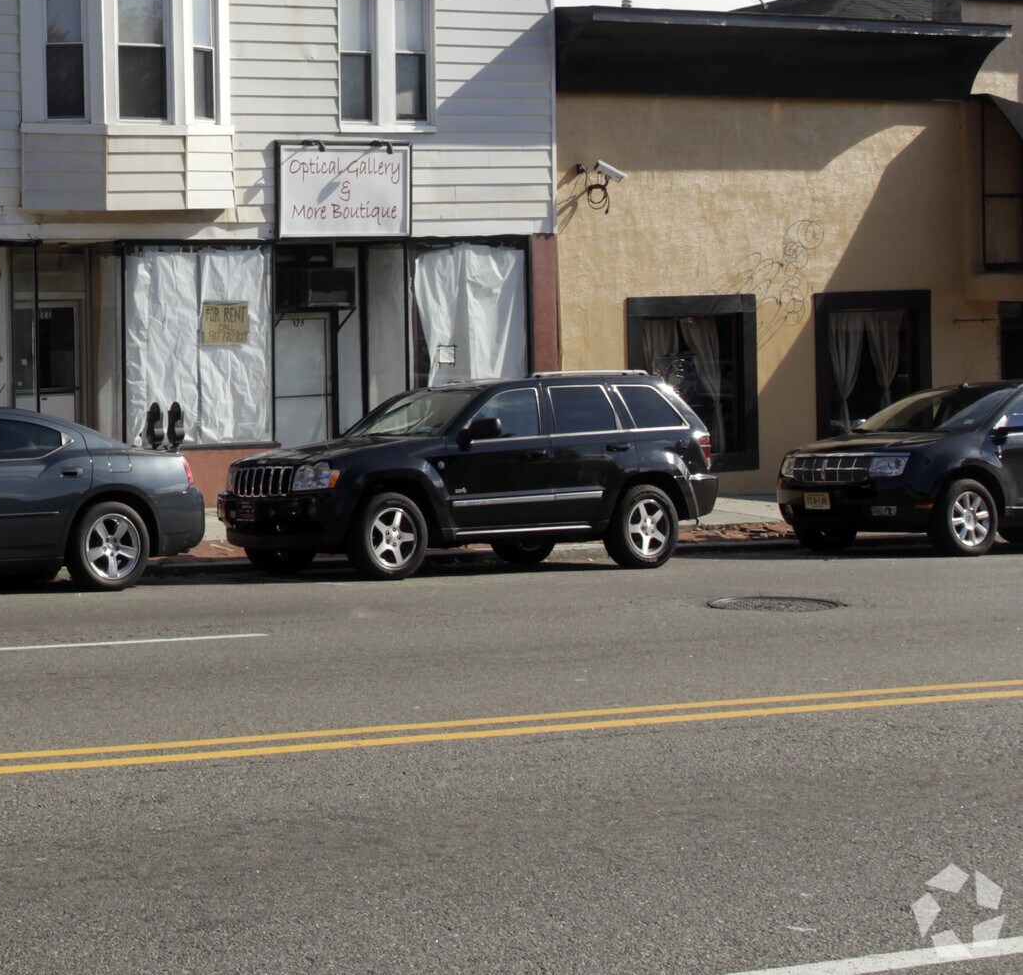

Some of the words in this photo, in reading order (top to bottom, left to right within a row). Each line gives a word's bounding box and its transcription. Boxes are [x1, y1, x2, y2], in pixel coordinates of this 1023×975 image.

[289, 156, 342, 183] Optical
[347, 157, 401, 185] Gallery
[339, 180, 352, 202] &
[291, 204, 328, 220] More
[330, 200, 398, 226] Boutique
[205, 307, 221, 323] FOR
[223, 306, 247, 323] RENT
